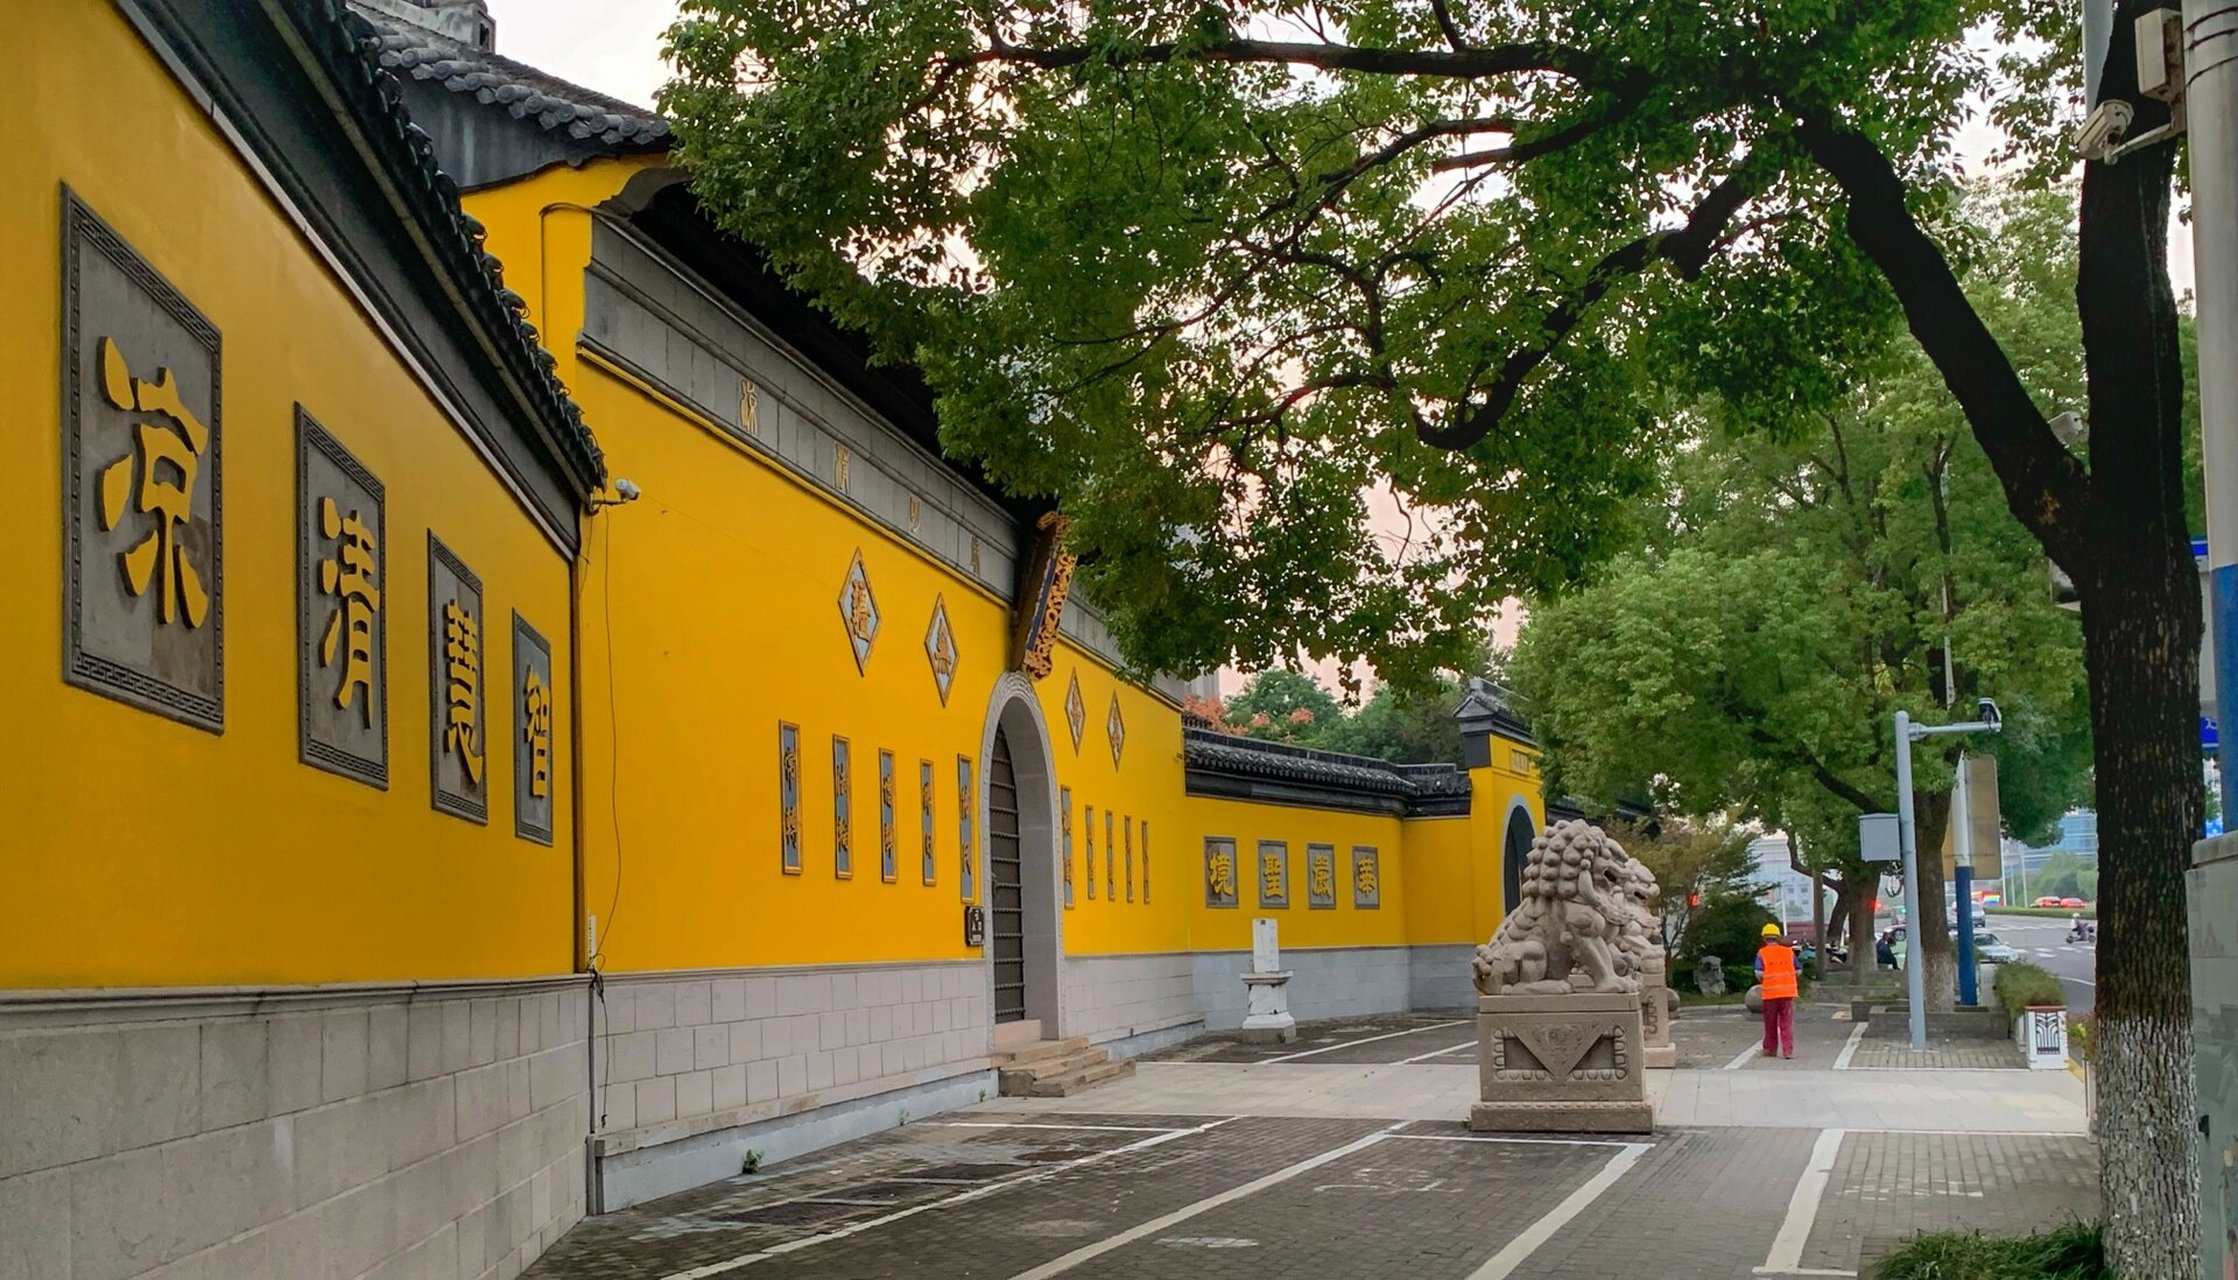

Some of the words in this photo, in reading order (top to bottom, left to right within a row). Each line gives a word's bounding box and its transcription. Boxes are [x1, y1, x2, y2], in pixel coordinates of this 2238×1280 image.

[319, 495, 379, 729] 清
[444, 599, 483, 785] 慧
[526, 665, 551, 797] 智
[1209, 852, 1233, 896] 境
[1264, 853, 1283, 898] 聖
